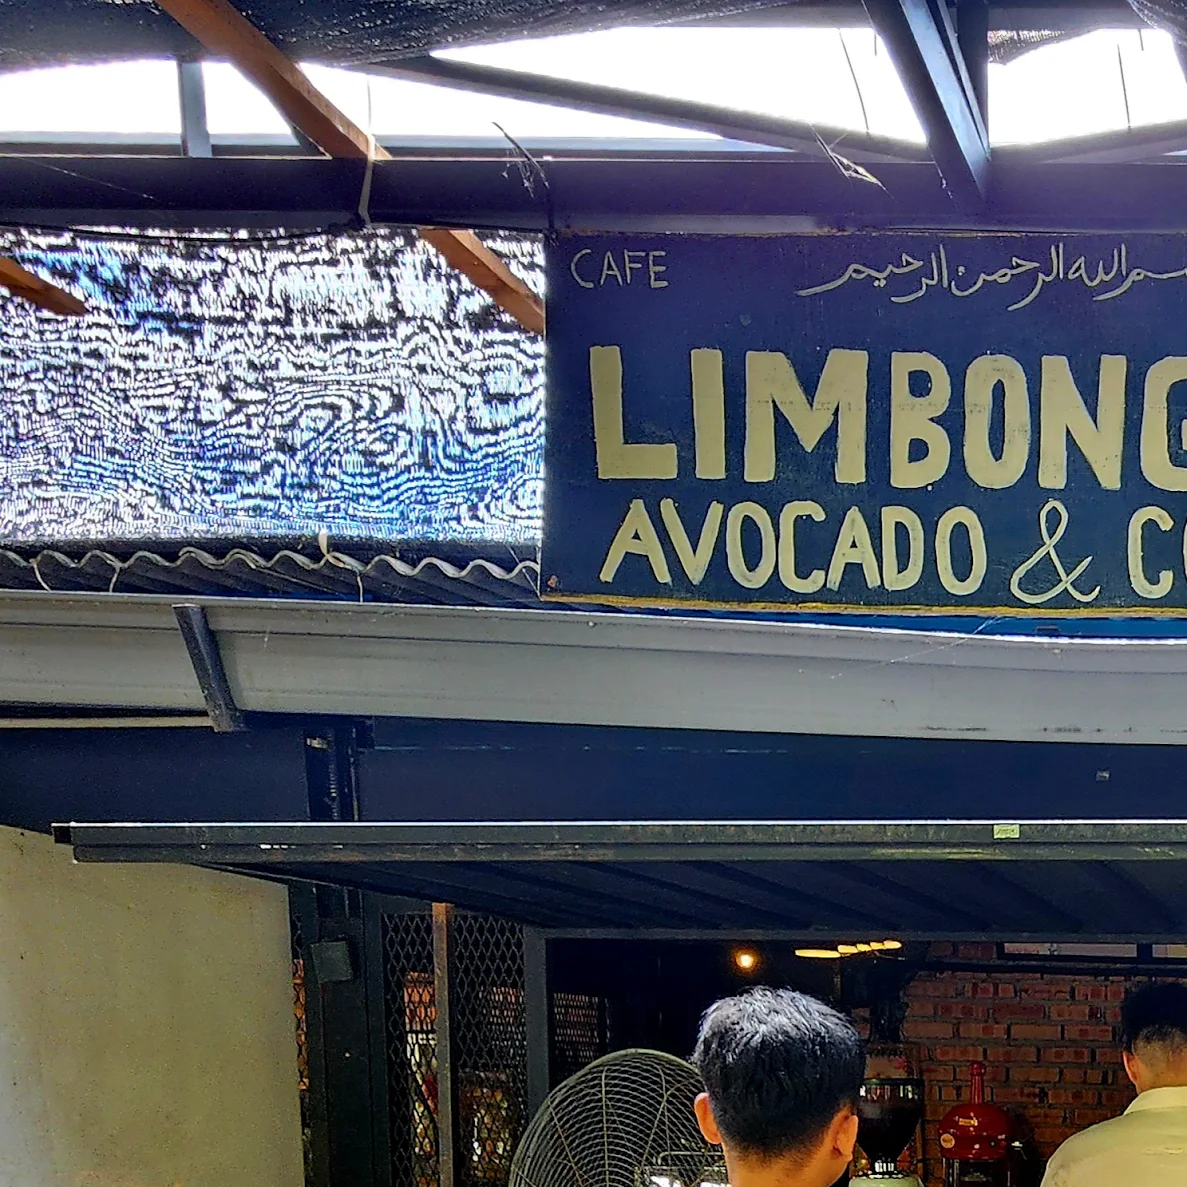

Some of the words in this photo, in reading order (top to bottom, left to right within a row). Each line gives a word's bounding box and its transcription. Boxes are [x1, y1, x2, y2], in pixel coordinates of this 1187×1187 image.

[570, 249, 669, 289] CAFE
[599, 497, 988, 596] AVOCADO
[1008, 497, 1101, 604] &
